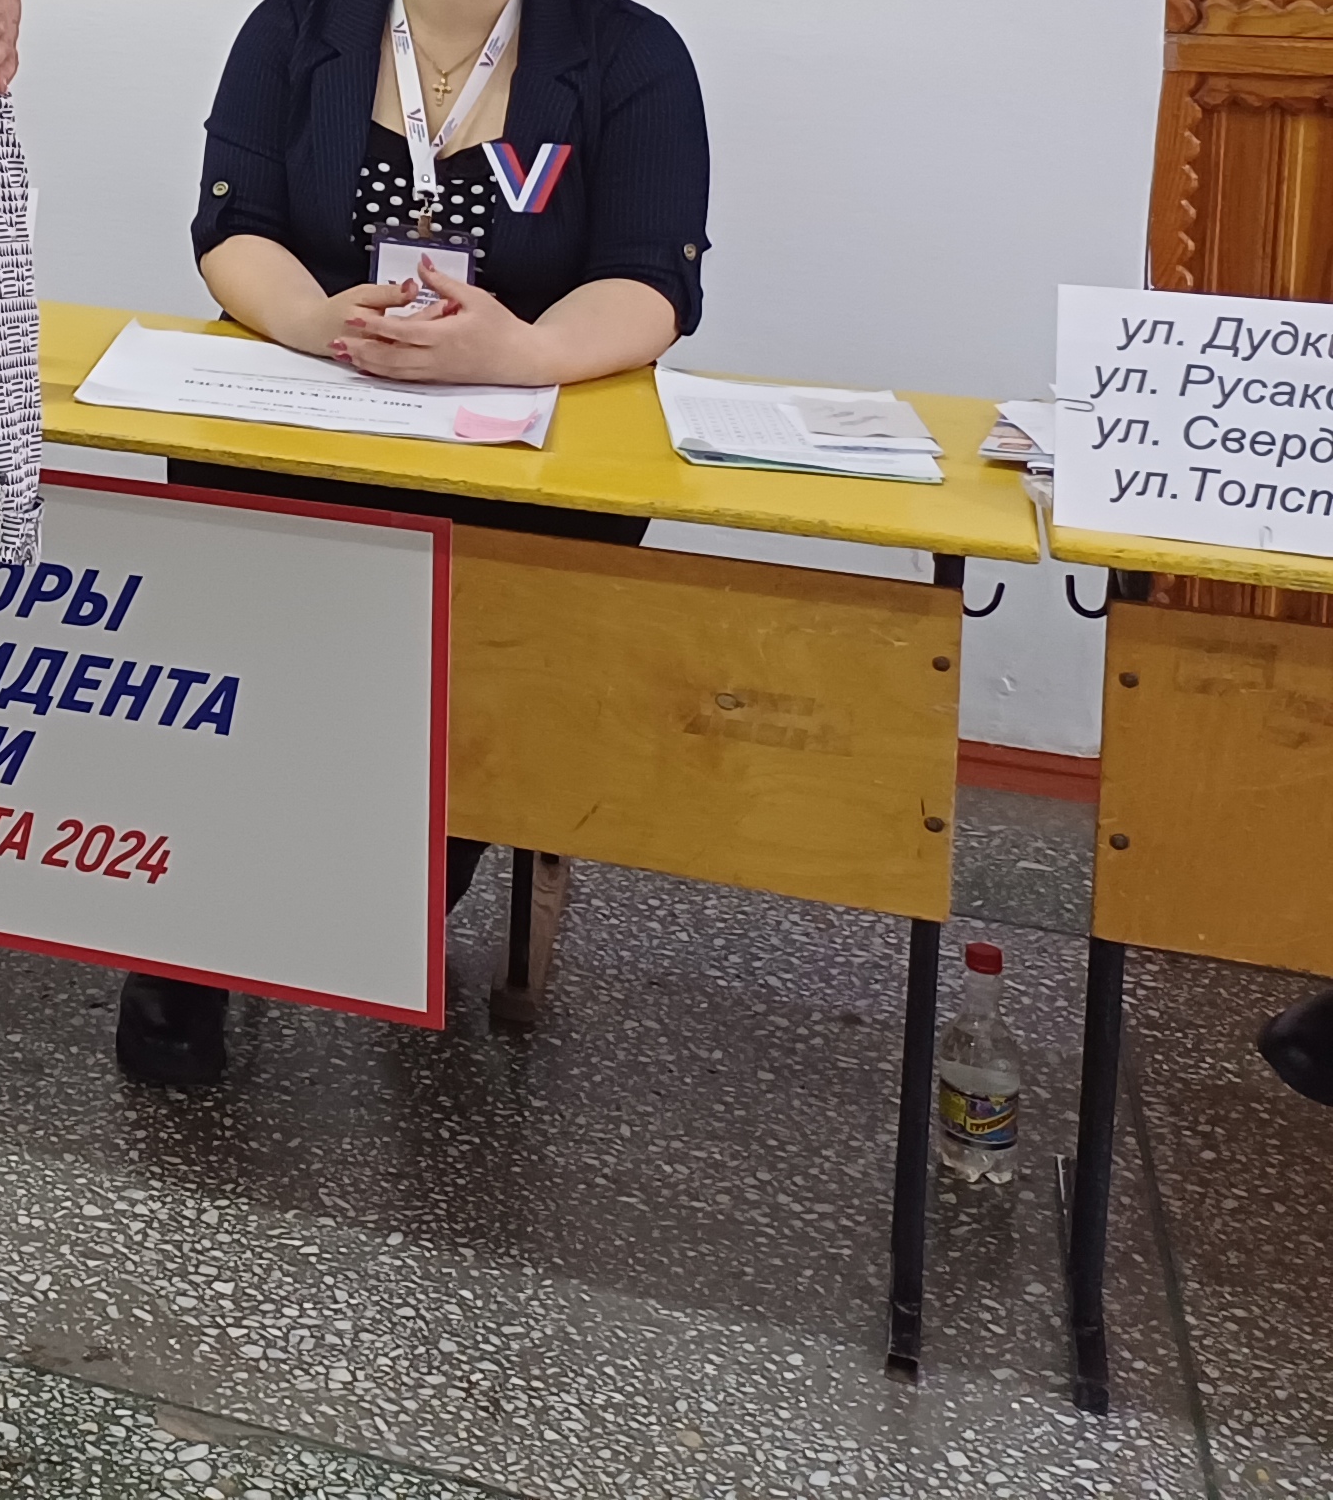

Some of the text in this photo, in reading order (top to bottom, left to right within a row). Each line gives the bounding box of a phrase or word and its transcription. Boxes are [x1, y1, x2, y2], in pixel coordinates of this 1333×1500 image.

[1115, 315, 1333, 361] ул. Дудк
[1090, 365, 1158, 399] ул.
[1091, 415, 1160, 450] ул.
[39, 816, 172, 885] 2024
